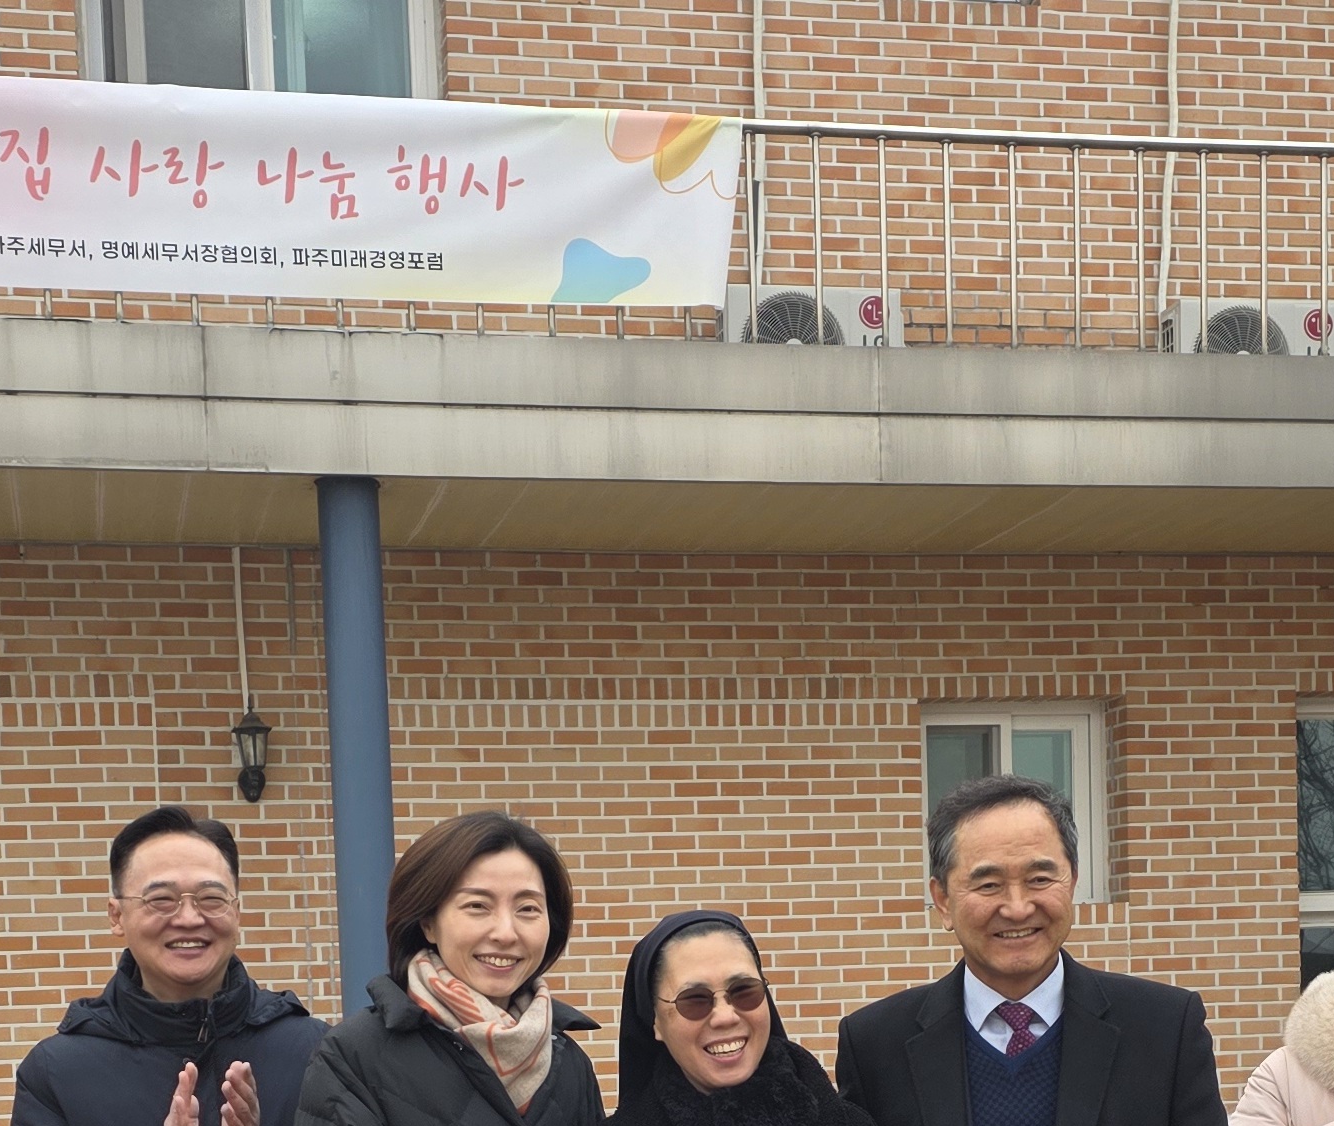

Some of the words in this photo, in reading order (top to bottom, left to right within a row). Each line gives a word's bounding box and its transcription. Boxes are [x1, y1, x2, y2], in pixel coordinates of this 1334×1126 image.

[89, 139, 225, 209] 사랑
[257, 147, 359, 220] 나눔
[386, 144, 525, 215] 행사
[101, 240, 284, 268] 명예세무서장협의회,
[292, 247, 444, 271] 파주미래경영포럼
